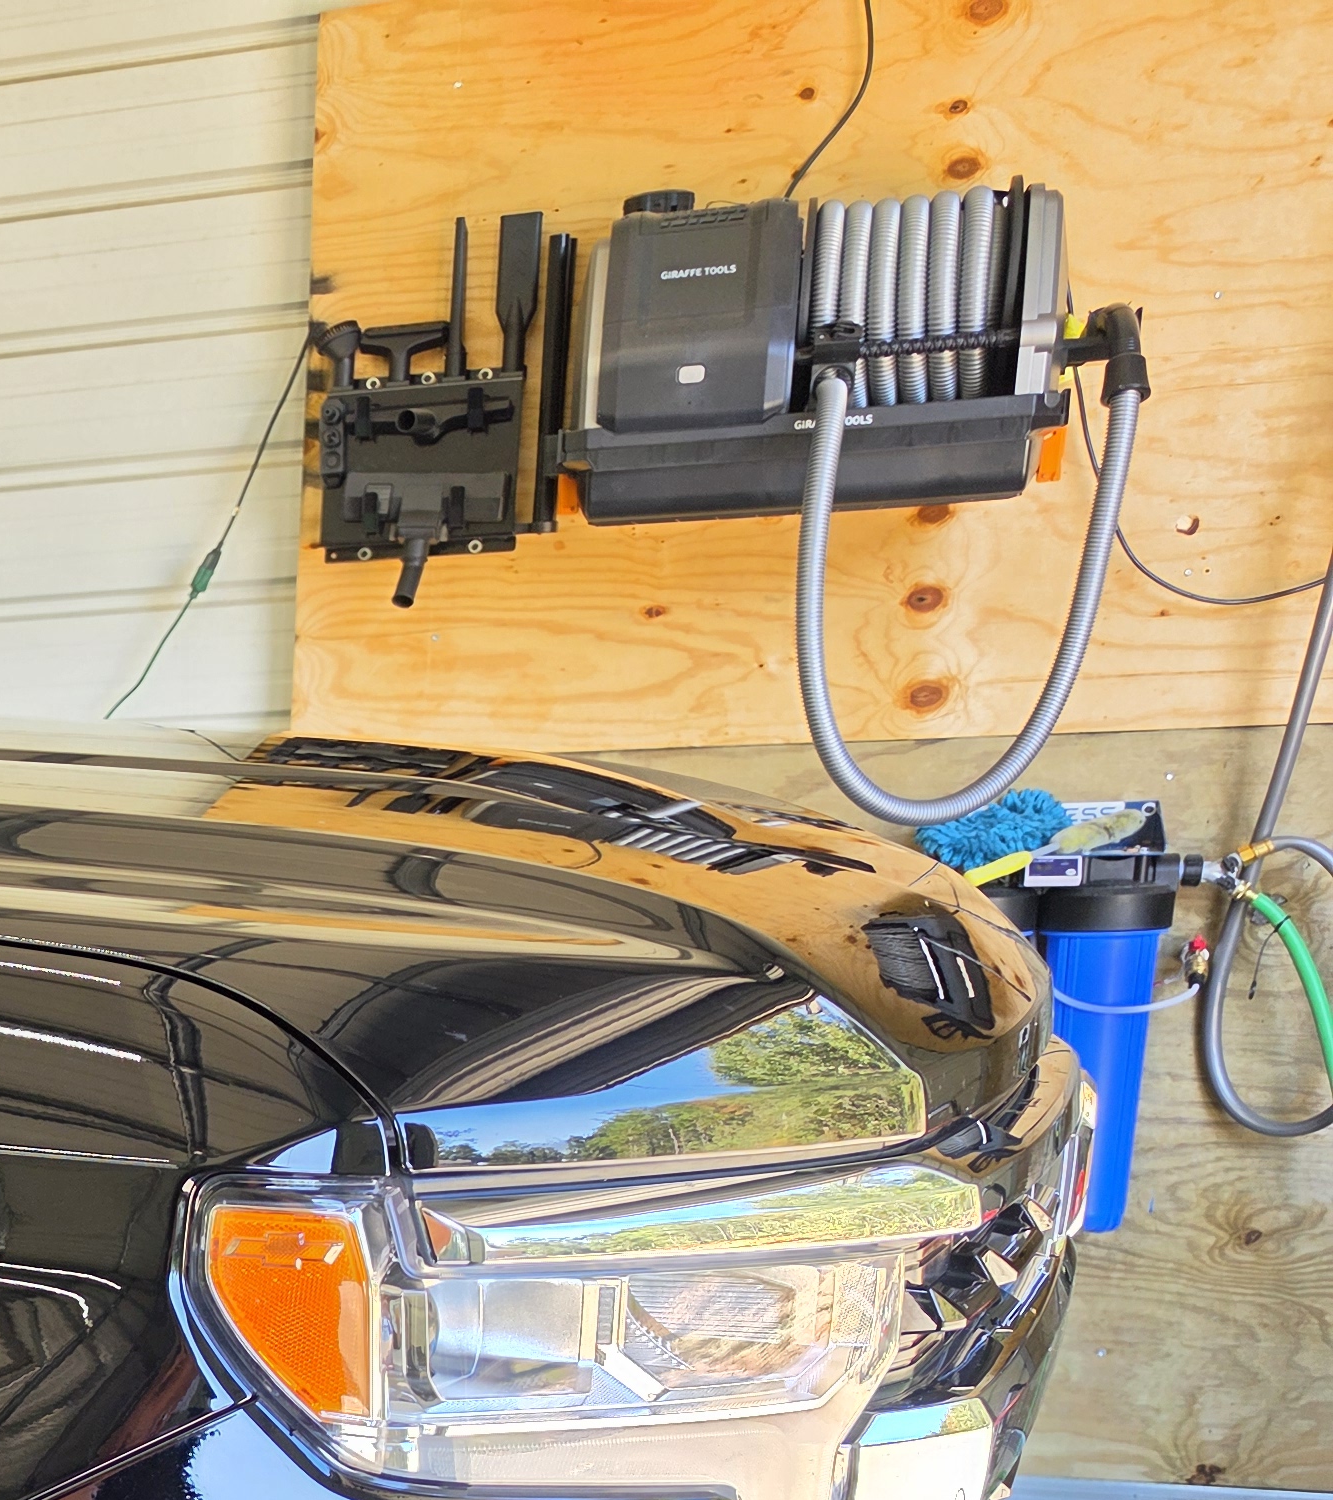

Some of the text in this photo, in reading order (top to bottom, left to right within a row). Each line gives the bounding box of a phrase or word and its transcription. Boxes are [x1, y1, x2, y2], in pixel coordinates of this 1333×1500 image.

[660, 264, 737, 280] GIRAFFE TOOLS
[844, 413, 873, 427] OOLS
